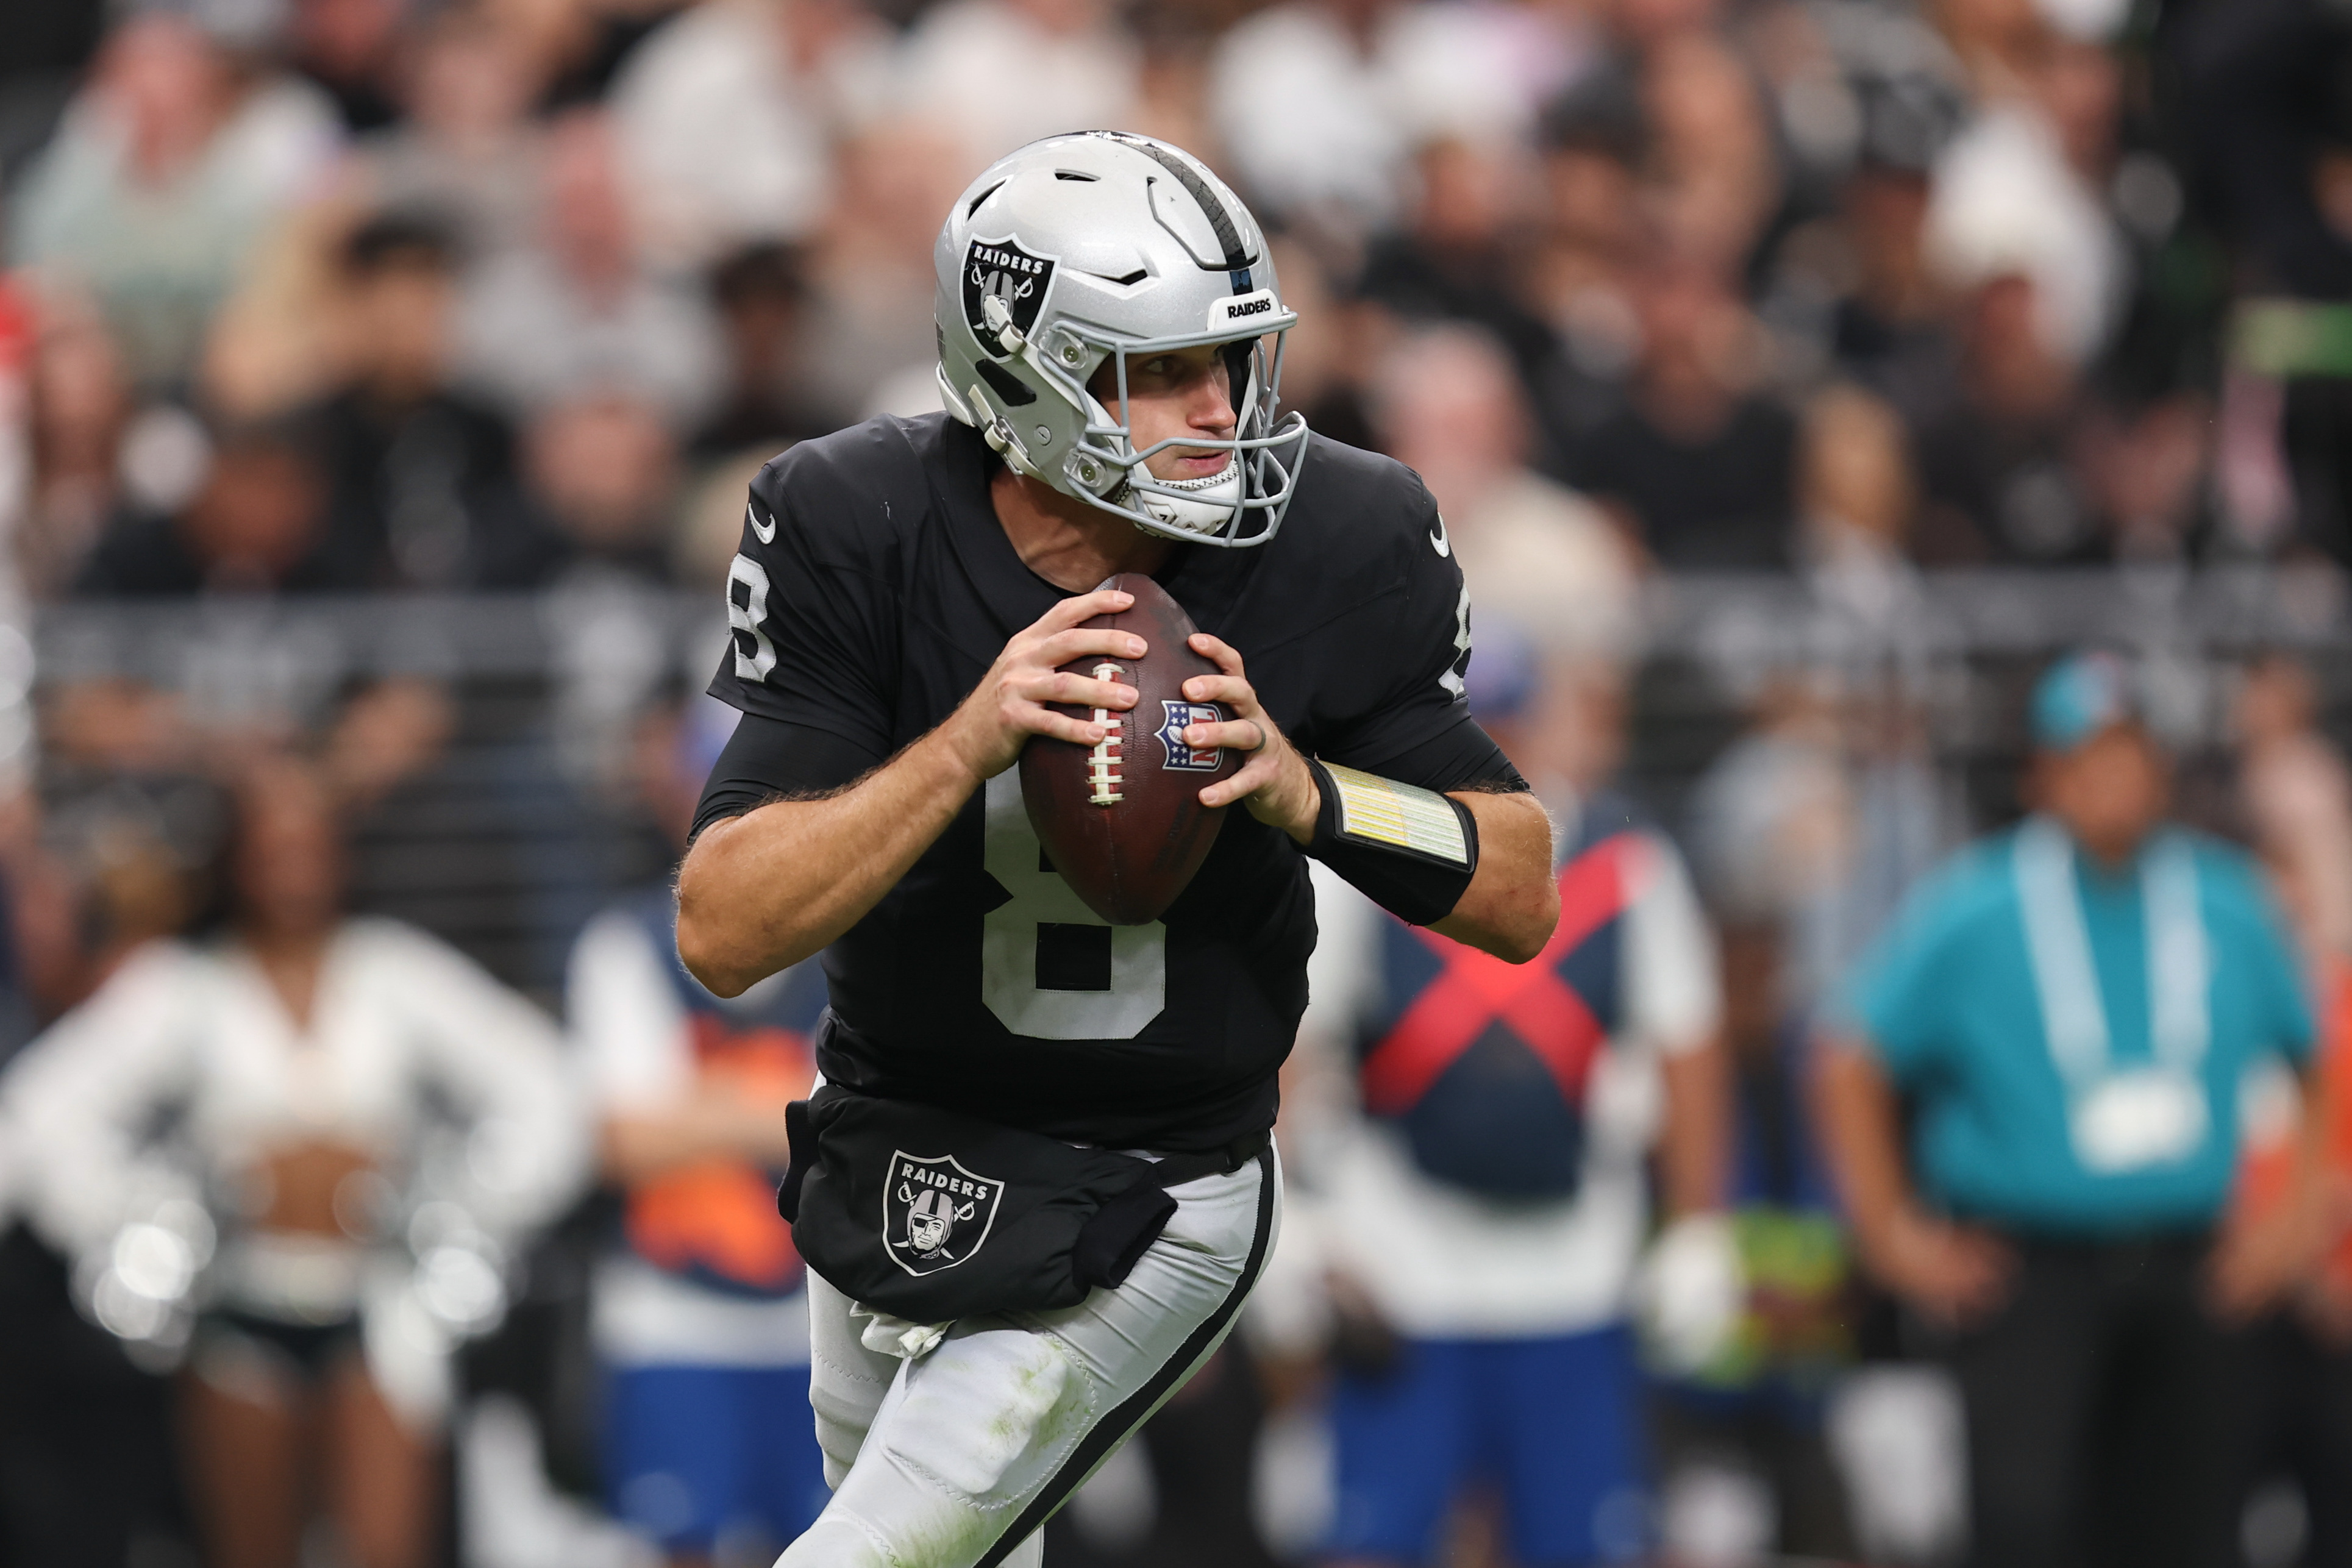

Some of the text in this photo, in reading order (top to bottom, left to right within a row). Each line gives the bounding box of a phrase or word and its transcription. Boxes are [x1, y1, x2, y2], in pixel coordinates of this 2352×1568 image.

[974, 245, 1044, 274] RAIDERS
[1227, 298, 1271, 318] RAIDERS
[1192, 711, 1218, 764] NL
[901, 1163, 988, 1200] RAIDERS
